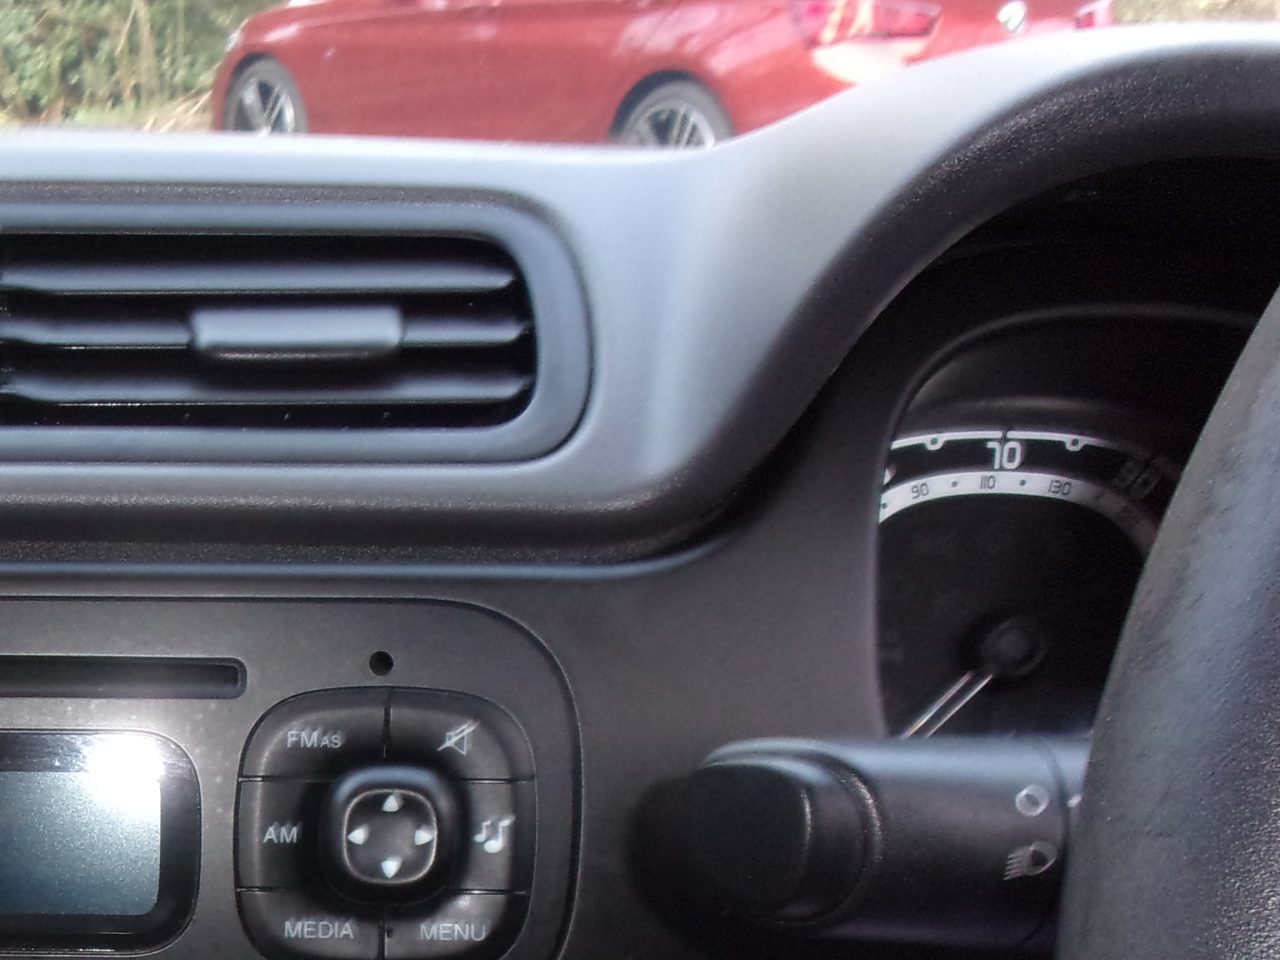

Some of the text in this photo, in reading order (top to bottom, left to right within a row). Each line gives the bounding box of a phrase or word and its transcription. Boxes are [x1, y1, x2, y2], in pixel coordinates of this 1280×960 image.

[986, 440, 1022, 470] 70
[911, 475, 1072, 500] 90 110 130
[263, 825, 299, 844] AM
[284, 919, 355, 940] MEDIA
[420, 921, 488, 942] MENU
